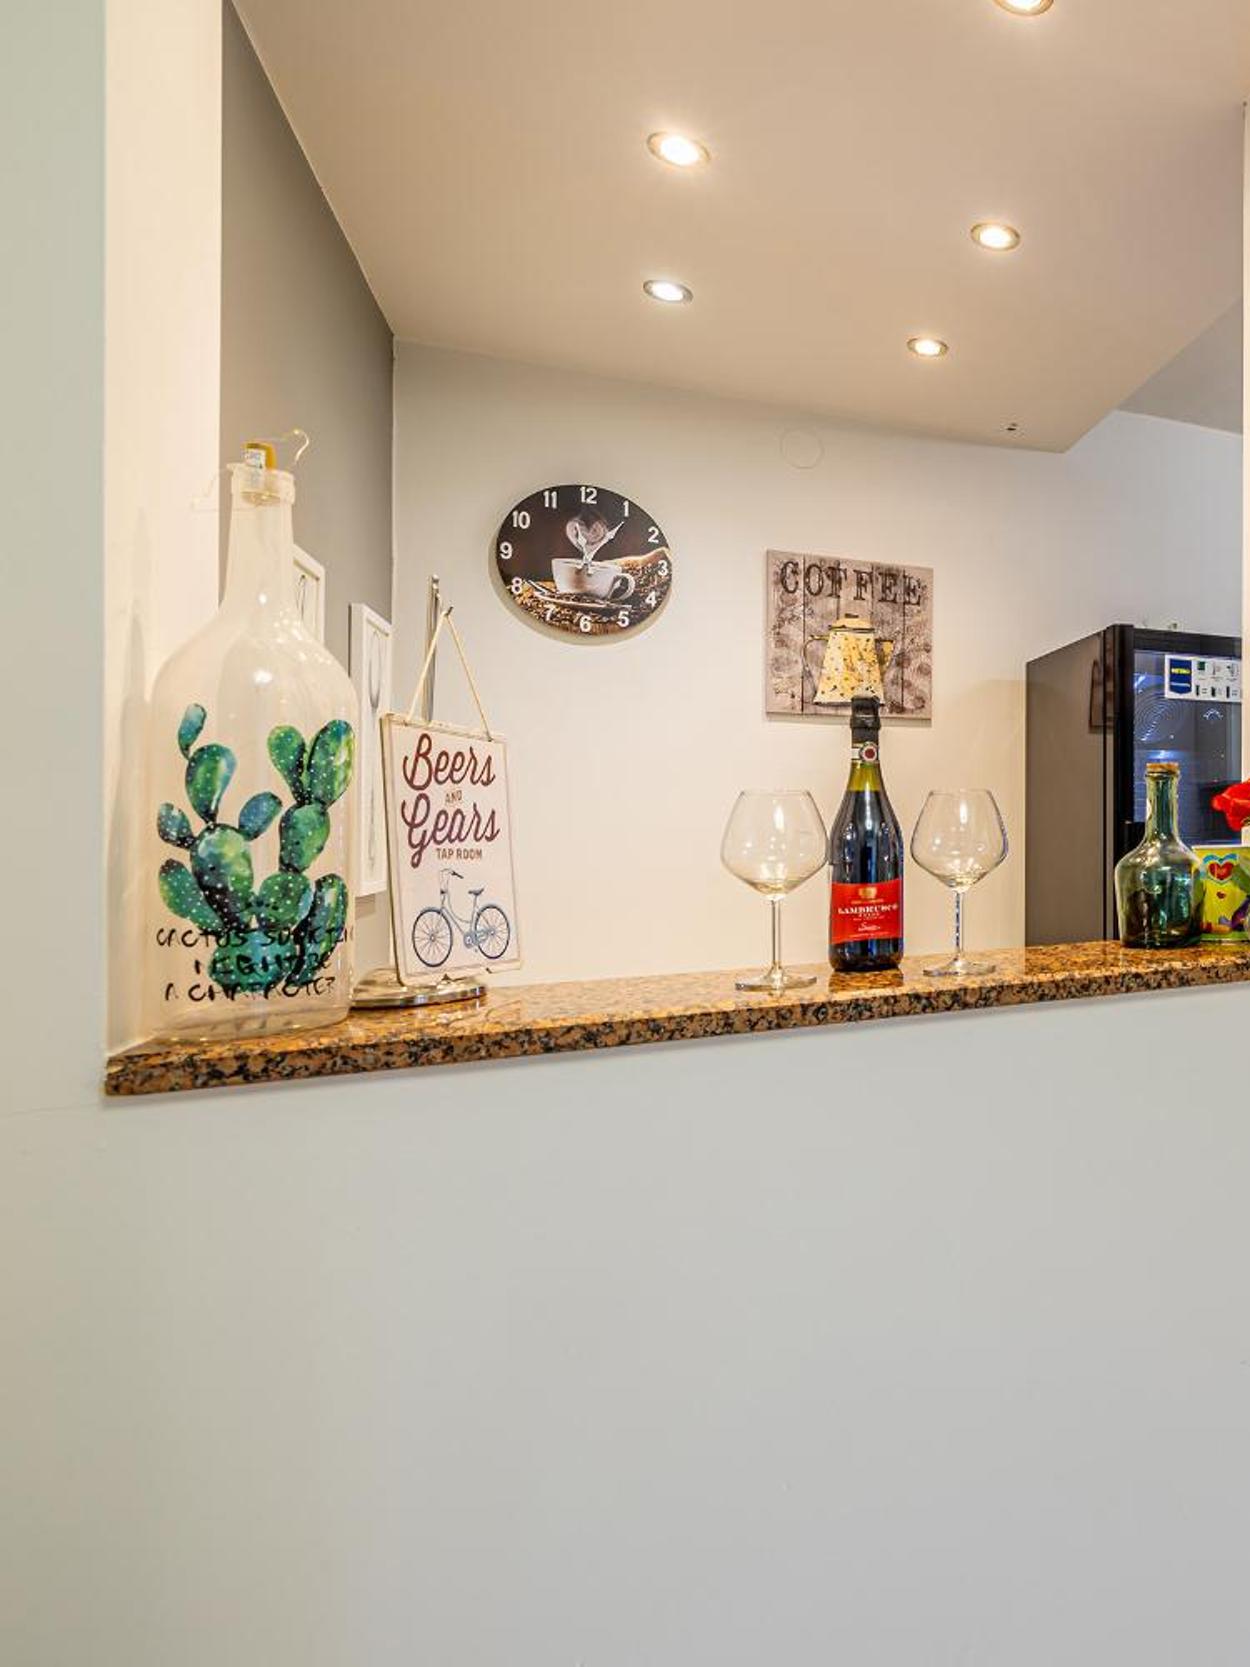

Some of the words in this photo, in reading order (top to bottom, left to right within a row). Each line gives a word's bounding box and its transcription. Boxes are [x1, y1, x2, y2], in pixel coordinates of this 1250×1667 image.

[543, 490, 557, 509] 11
[580, 486, 597, 505] 12
[622, 500, 629, 517] 1
[512, 510, 530, 529] 10
[648, 526, 659, 544] 2
[499, 541, 512, 559] 9
[657, 559, 667, 576] 3
[511, 577, 522, 594] 8
[780, 561, 921, 606] COFFEE
[645, 591, 657, 607] 4
[543, 604, 555, 621] 7
[616, 611, 629, 628] 5
[579, 615, 591, 632] 6
[402, 733, 496, 791] Beers
[445, 790, 463, 803] AND
[401, 793, 501, 869] Gears
[435, 848, 454, 860] TAP
[456, 848, 483, 860] ROOM
